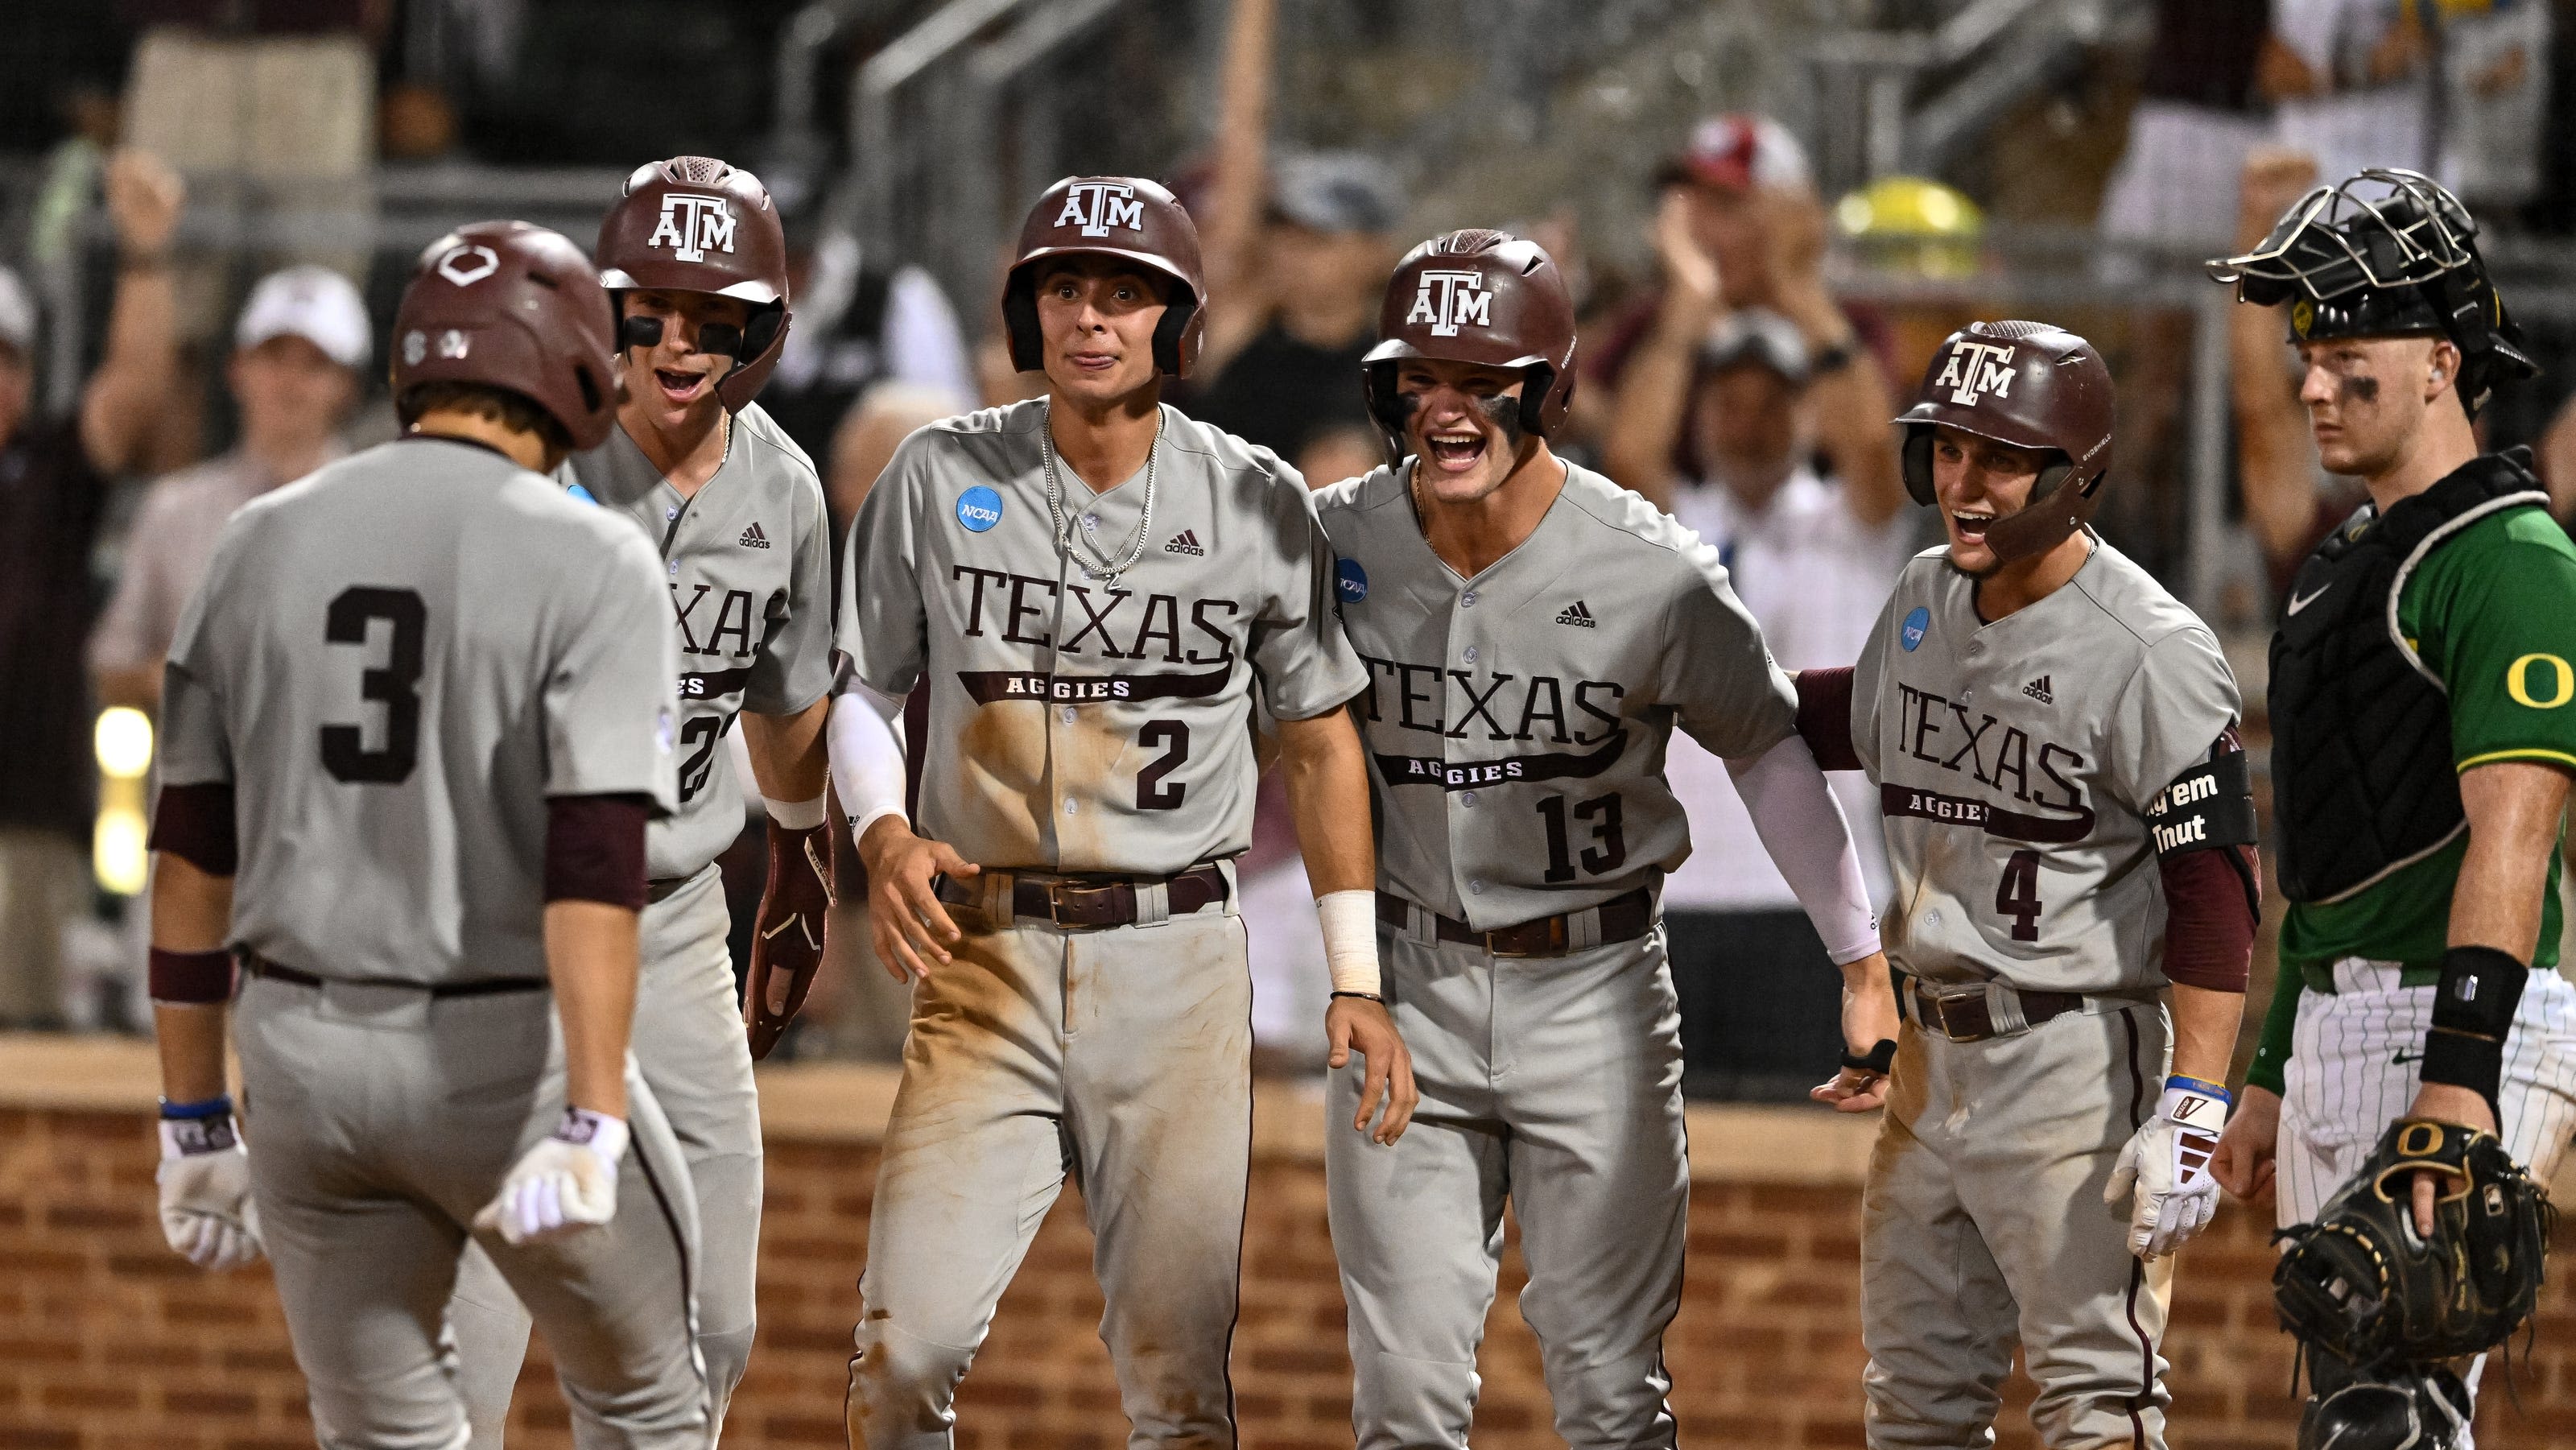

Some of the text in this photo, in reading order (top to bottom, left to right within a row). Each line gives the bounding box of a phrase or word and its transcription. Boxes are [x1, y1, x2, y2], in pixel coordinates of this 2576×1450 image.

[961, 504, 998, 523] NCAA
[739, 536, 770, 550] adidas
[1165, 542, 1203, 557] adidas
[953, 565, 1239, 665] TEXAS
[1556, 614, 1596, 629] adidas
[319, 584, 427, 783] 3
[1006, 676, 1130, 699] AGGIES
[1356, 651, 1624, 746] TEXAS
[2022, 685, 2054, 705] adidas
[2507, 653, 2574, 709] O
[1136, 720, 1190, 810] 2
[1898, 682, 2085, 809] TEXAS
[1409, 759, 1522, 784] AGGIES
[1536, 791, 1627, 883] 13
[1996, 849, 2042, 942] 4
[2397, 1122, 2445, 1157] O
